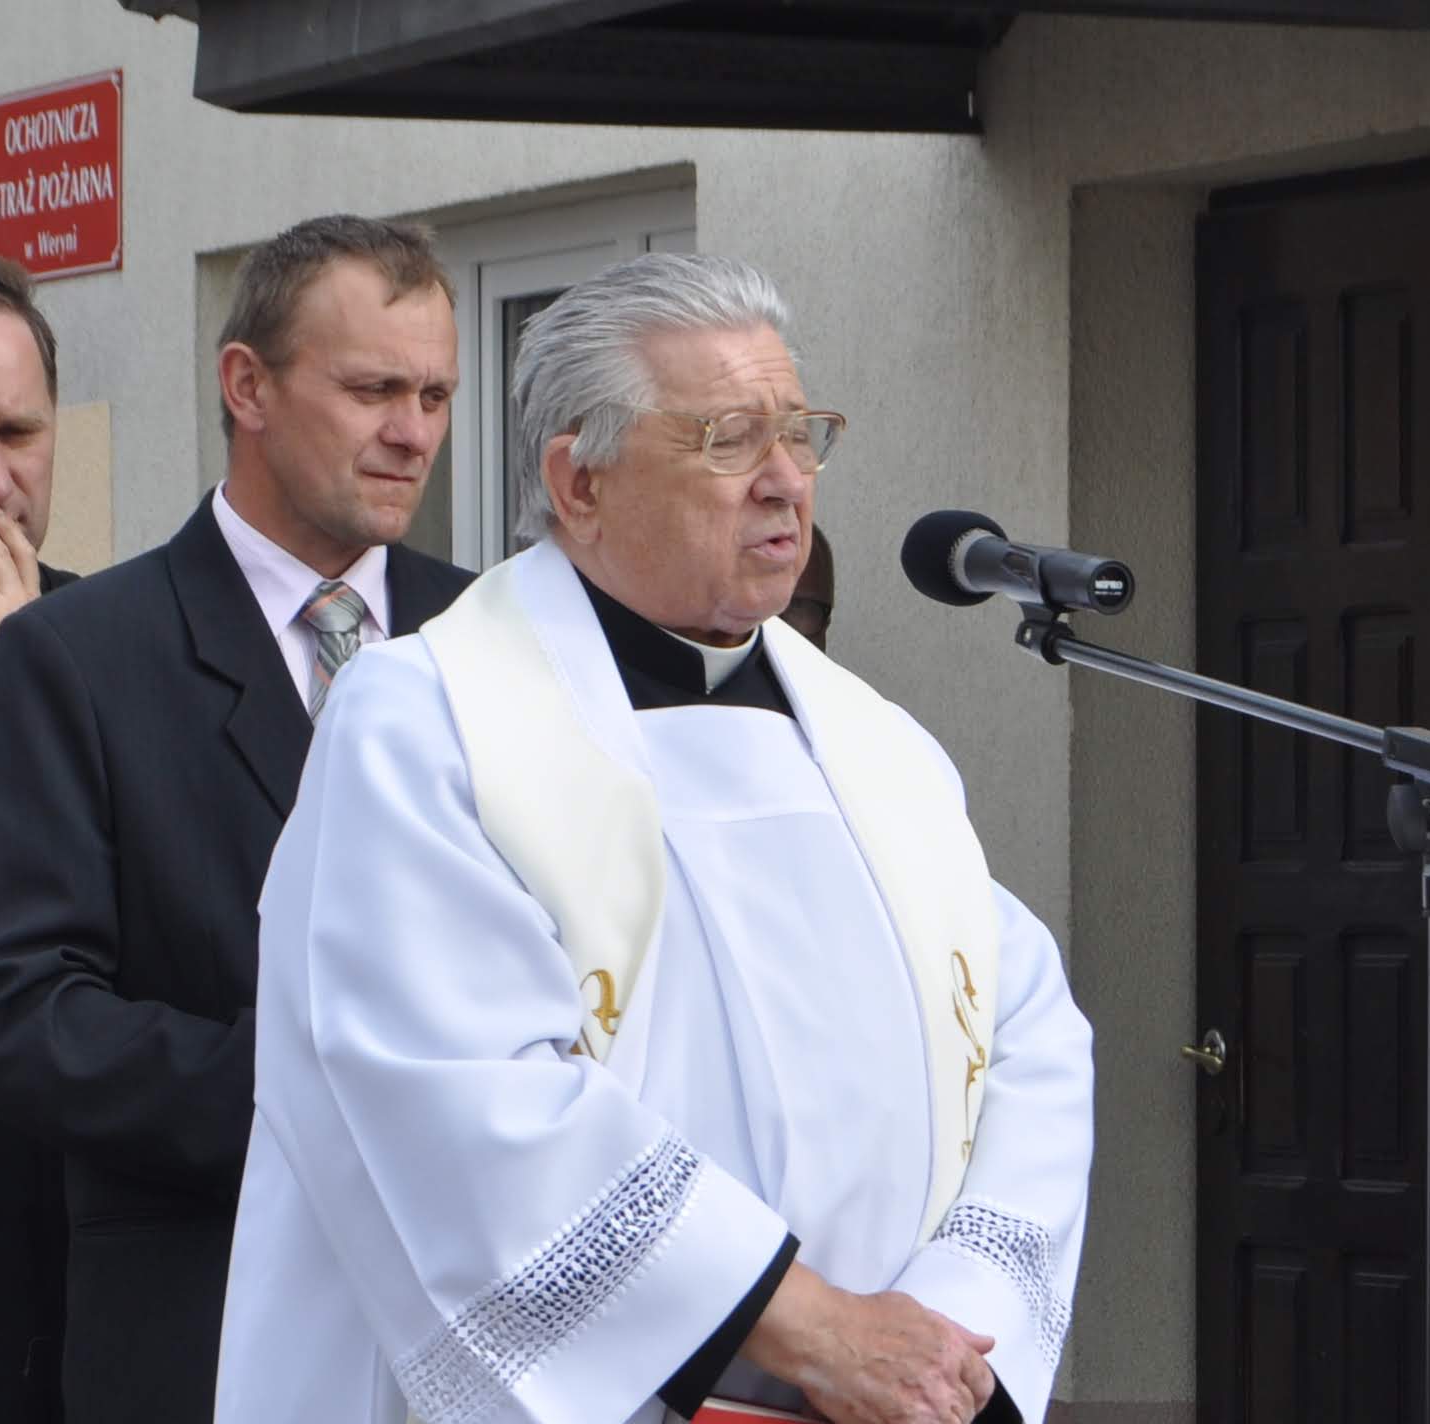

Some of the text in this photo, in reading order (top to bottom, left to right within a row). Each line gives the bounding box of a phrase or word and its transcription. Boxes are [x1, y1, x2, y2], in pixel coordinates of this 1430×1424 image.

[5, 100, 99, 157] OCHOTNICZA
[39, 160, 114, 211] POŻARNA
[38, 224, 78, 262] Weryni
